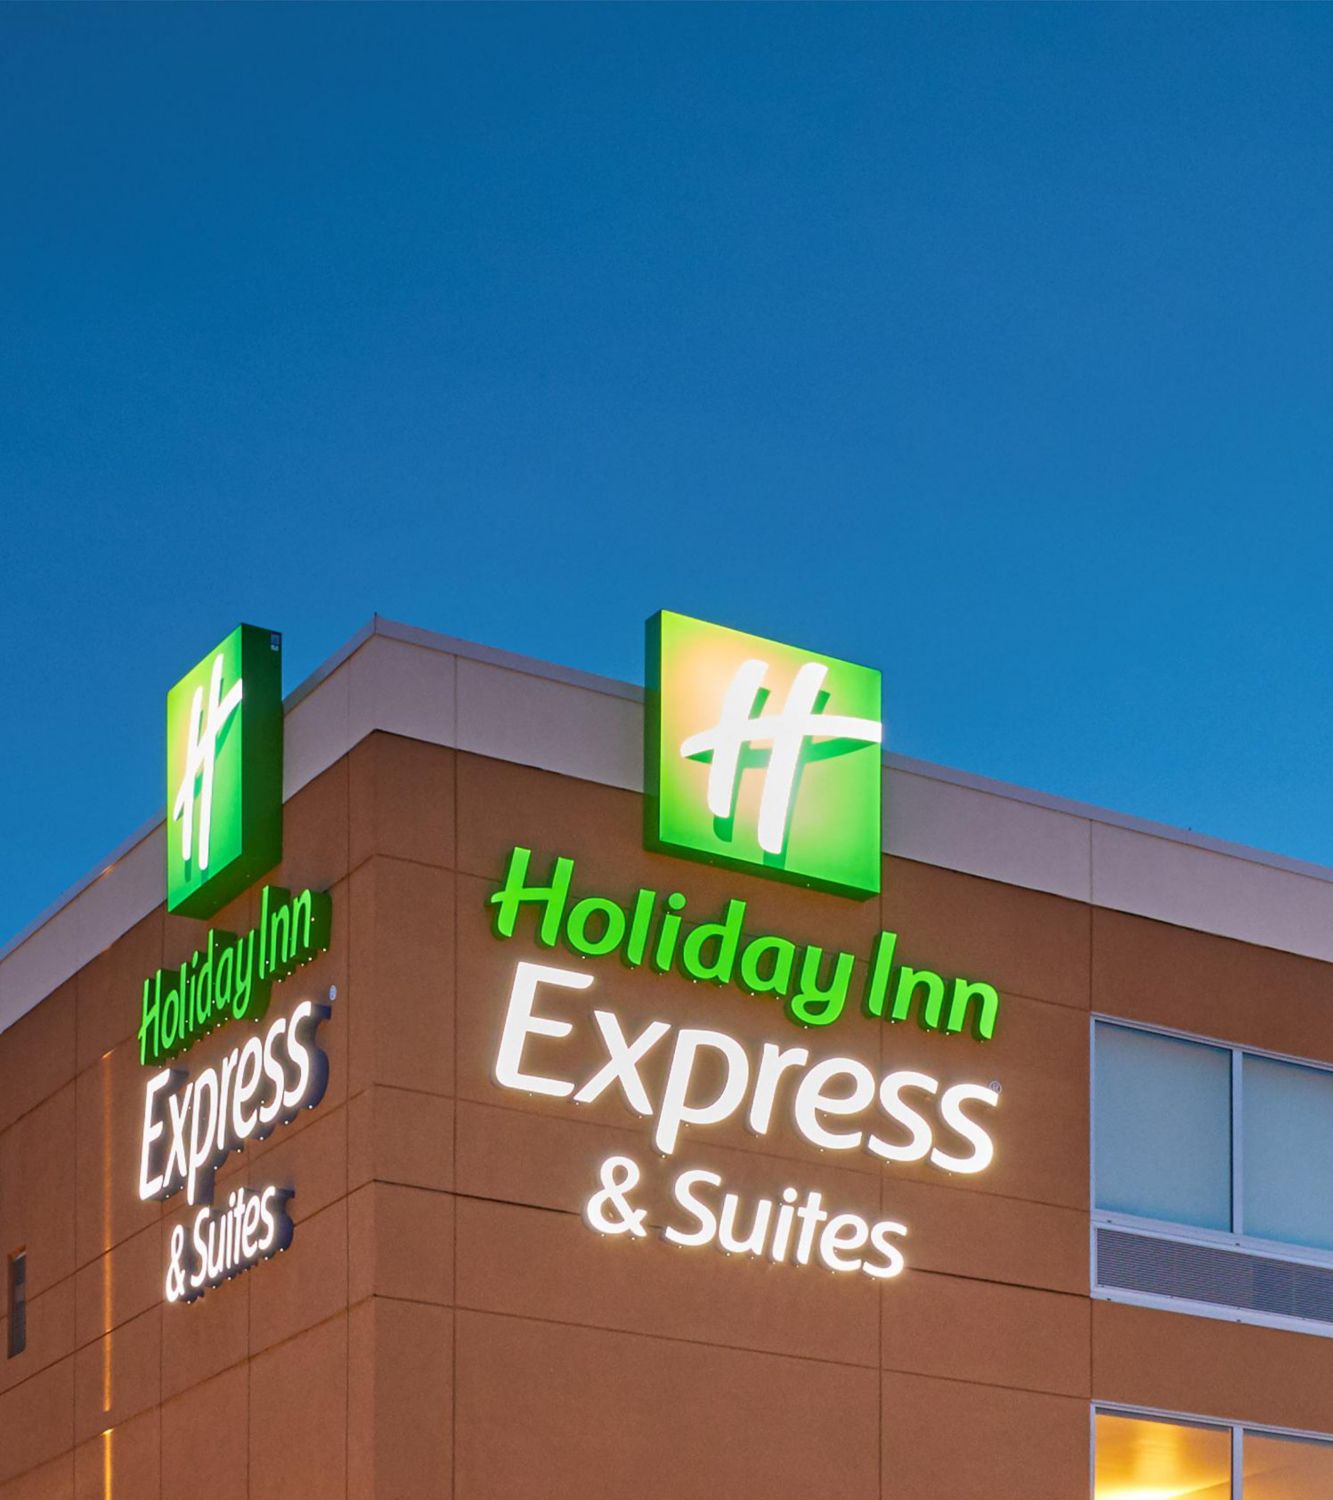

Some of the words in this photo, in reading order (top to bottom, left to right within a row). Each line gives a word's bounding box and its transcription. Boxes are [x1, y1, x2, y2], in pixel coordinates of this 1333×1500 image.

[139, 928, 255, 1066] Holiday
[260, 885, 312, 980] Inn
[491, 847, 854, 1025] Holiday
[868, 931, 999, 1040] Inn
[139, 1000, 312, 1206] Express
[495, 961, 1000, 1174] Express
[165, 1224, 186, 1302] &
[192, 1185, 277, 1288] Suites
[586, 1156, 648, 1238] &
[664, 1169, 908, 1279] Suites
